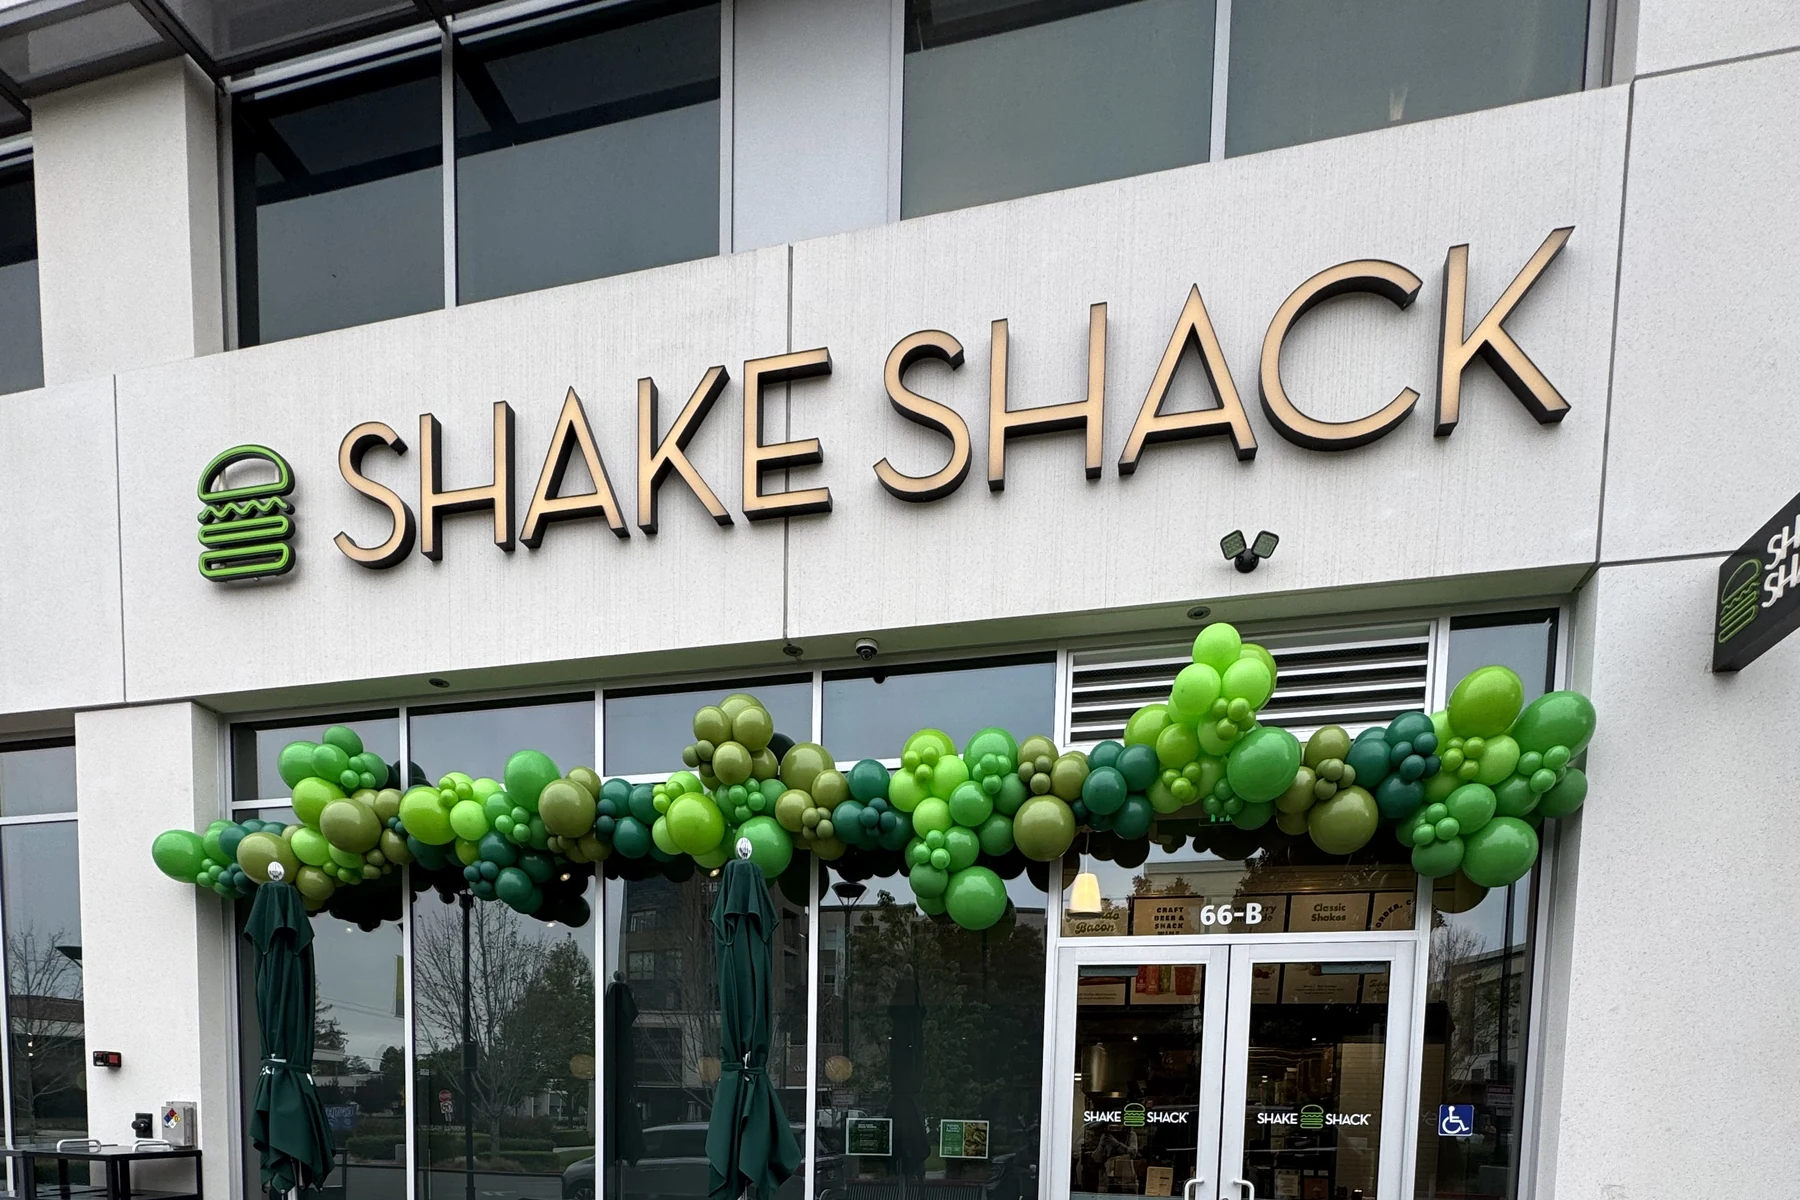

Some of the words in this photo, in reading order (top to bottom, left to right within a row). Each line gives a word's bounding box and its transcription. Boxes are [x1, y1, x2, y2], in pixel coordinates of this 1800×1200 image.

[333, 346, 833, 569] SHAKE
[872, 225, 1576, 503] SHACK
[1761, 552, 1800, 608] SH
[1313, 902, 1347, 912] Classic
[1200, 902, 1263, 926] 66-B
[1310, 912, 1347, 922] Shakes
[1074, 921, 1116, 935] Bacon
[1083, 1110, 1122, 1122] SHAKE
[1257, 1112, 1299, 1125] SHAKE
